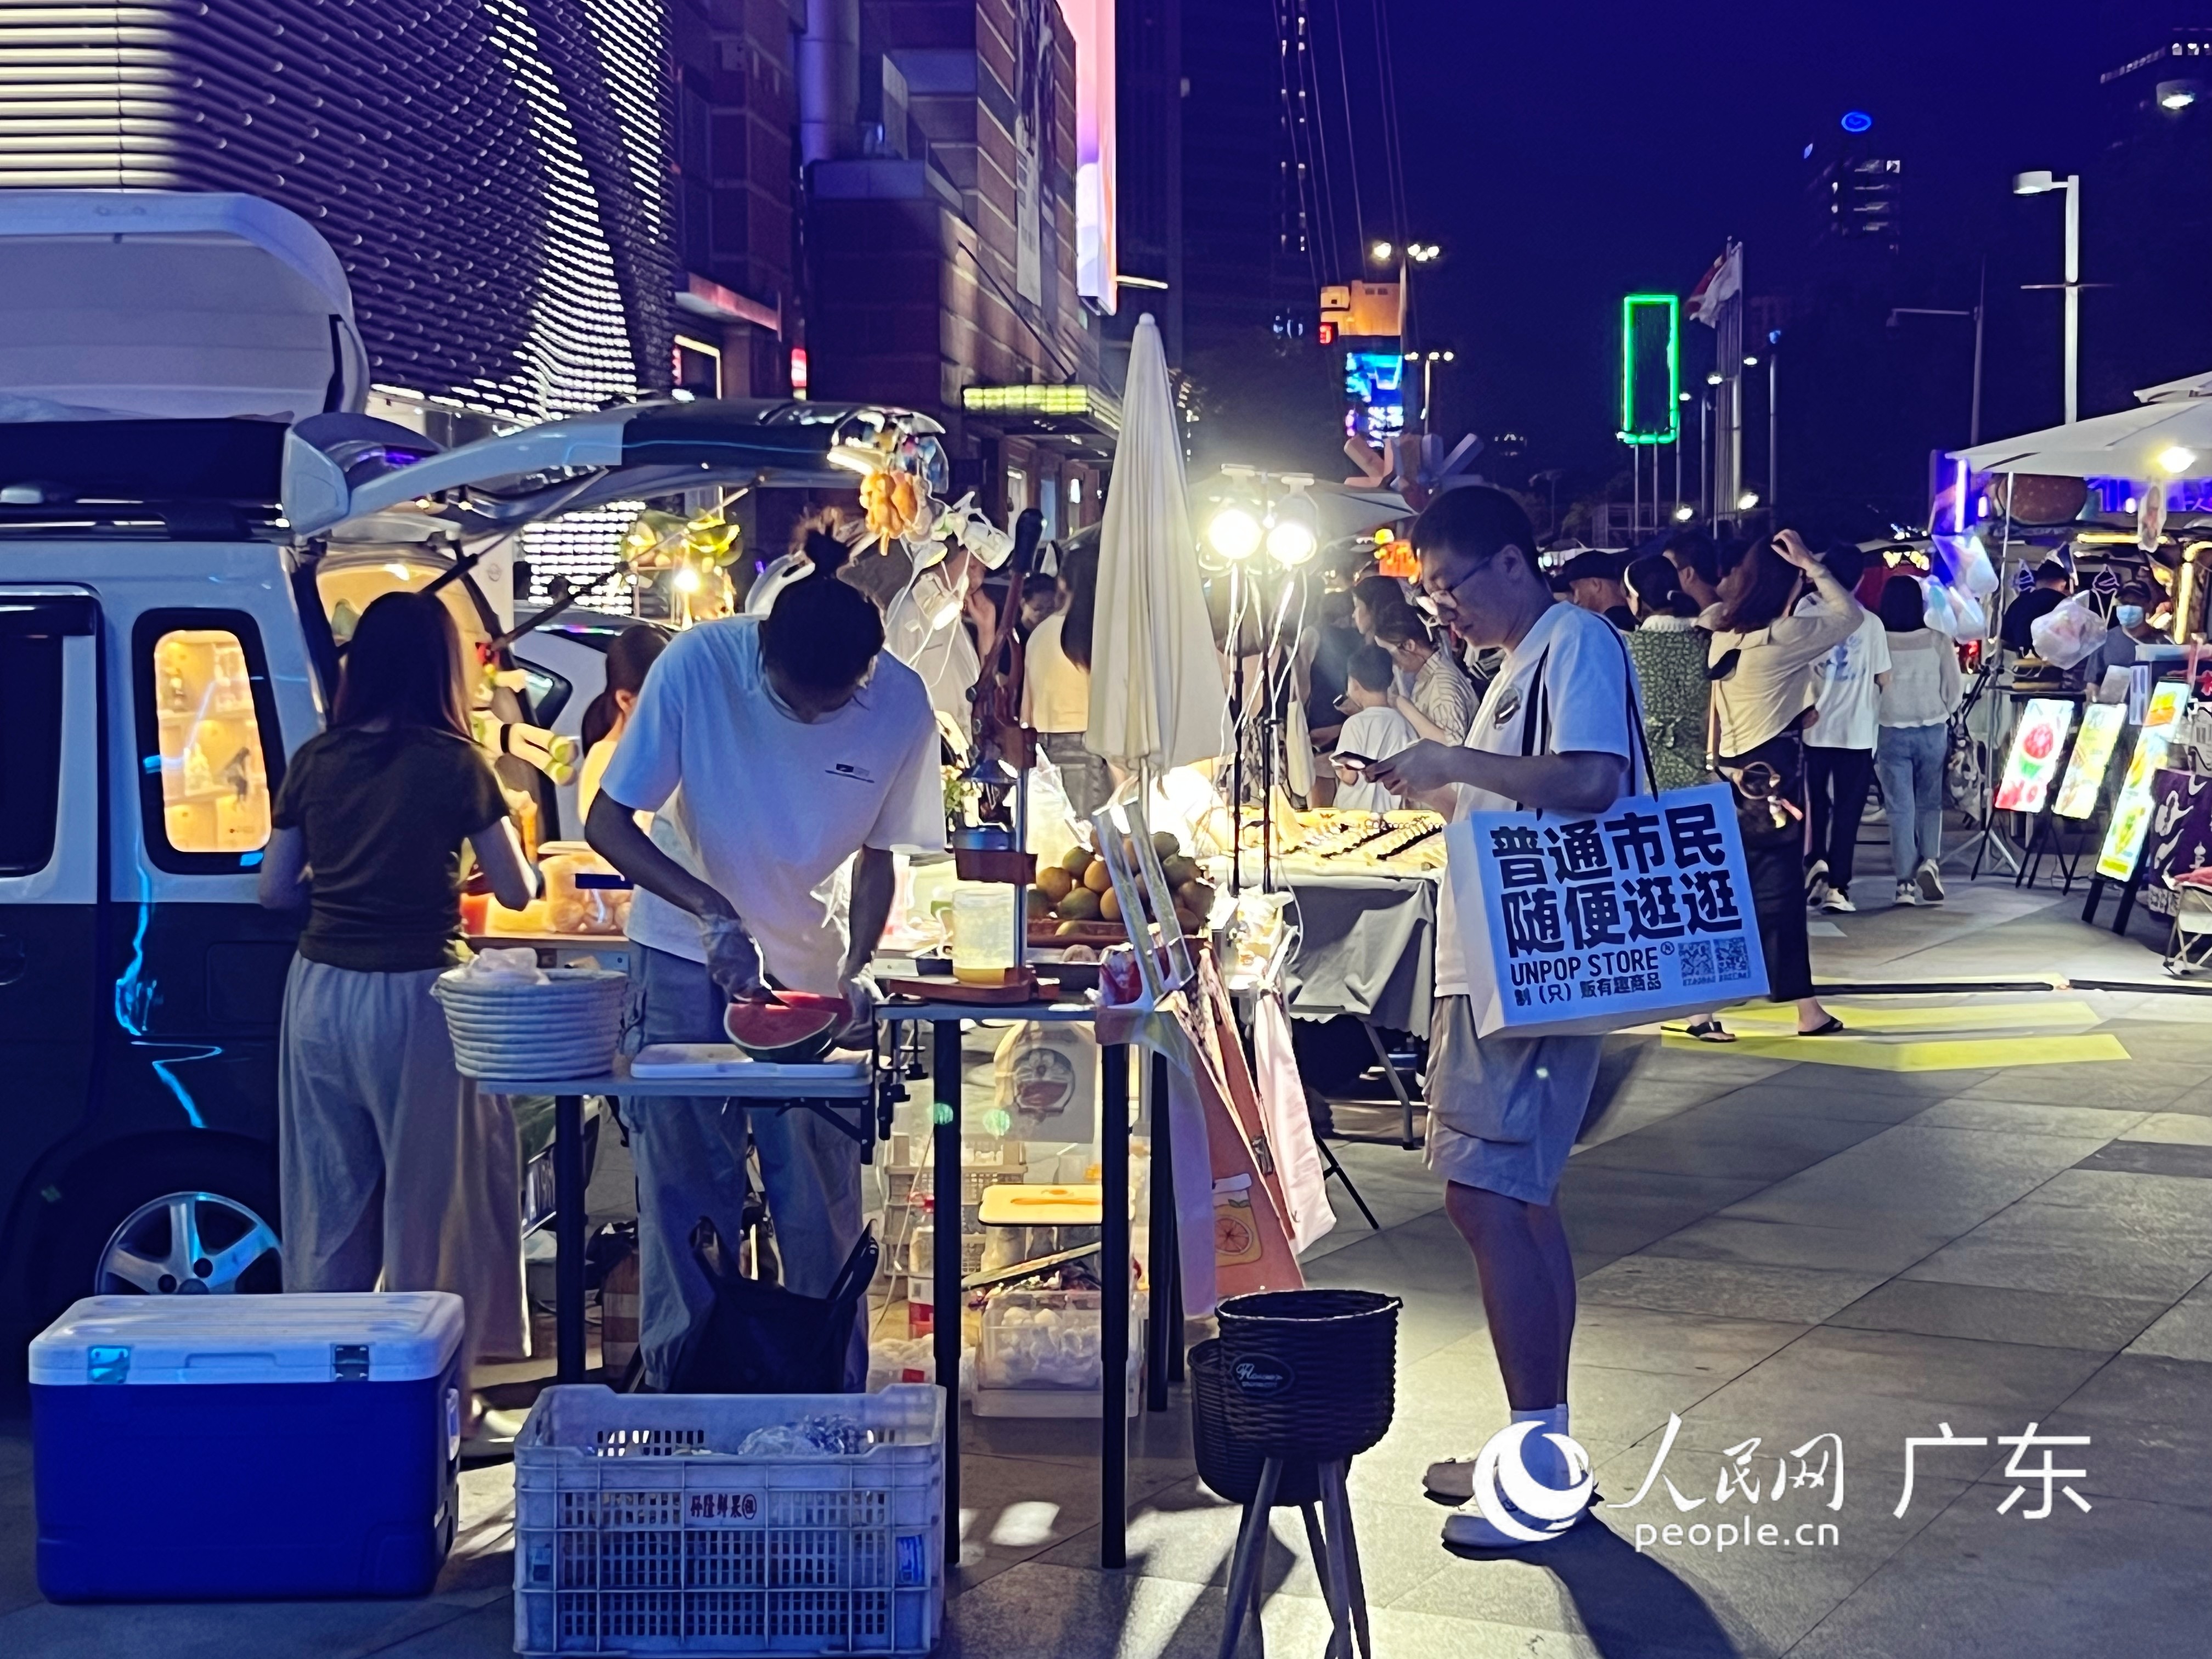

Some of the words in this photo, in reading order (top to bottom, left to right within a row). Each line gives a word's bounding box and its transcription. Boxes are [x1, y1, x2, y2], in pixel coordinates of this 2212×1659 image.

[1490, 803, 1726, 889] 普通市民
[1501, 870, 1743, 958] 随便逛逛
[1510, 957, 1581, 986] UNPOP
